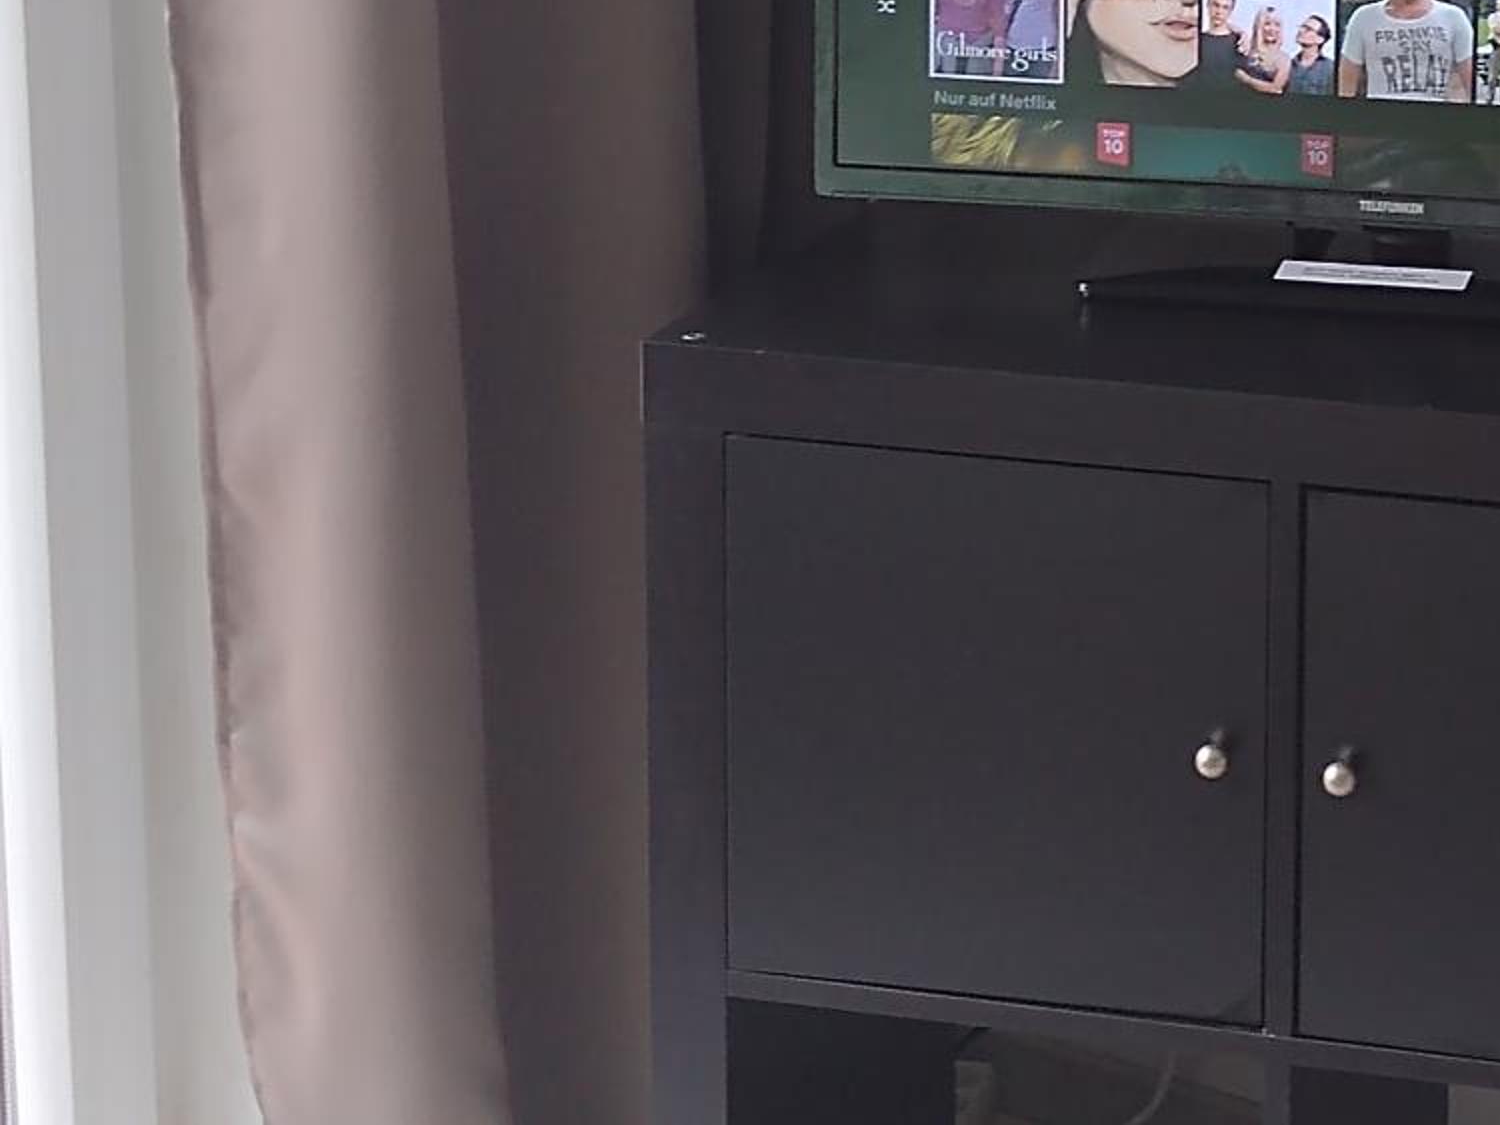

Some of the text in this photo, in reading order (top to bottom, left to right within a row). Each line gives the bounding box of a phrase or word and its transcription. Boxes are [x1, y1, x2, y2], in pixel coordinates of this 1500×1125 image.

[936, 30, 1058, 72] Gilmore girls
[934, 90, 1057, 110] Nur auf Netflix
[1103, 138, 1124, 155] 10
[1307, 149, 1328, 166] 10
